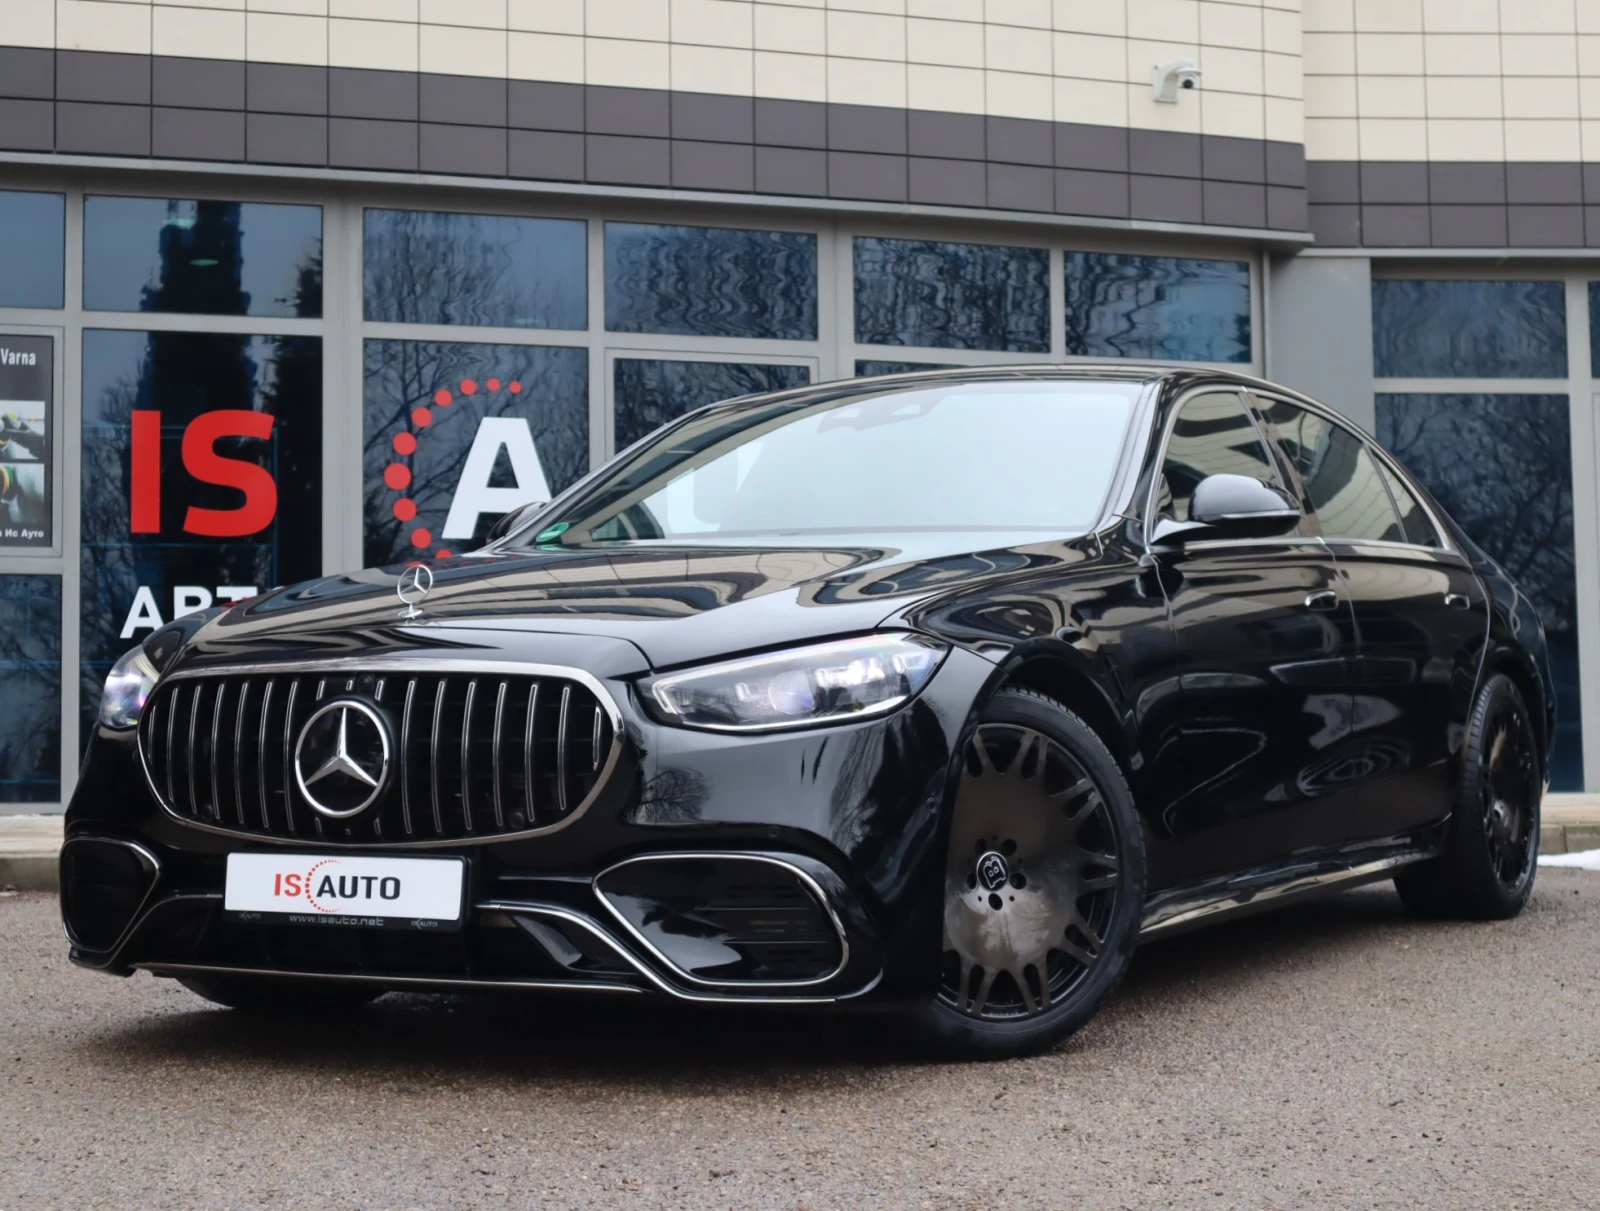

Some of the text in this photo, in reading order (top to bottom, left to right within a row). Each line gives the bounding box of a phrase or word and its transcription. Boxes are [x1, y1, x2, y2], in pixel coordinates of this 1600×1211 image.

[1, 348, 36, 366] Varna
[131, 409, 278, 537] IS
[274, 873, 401, 900] IS AUTO
[289, 914, 384, 927] www.isauto.net
